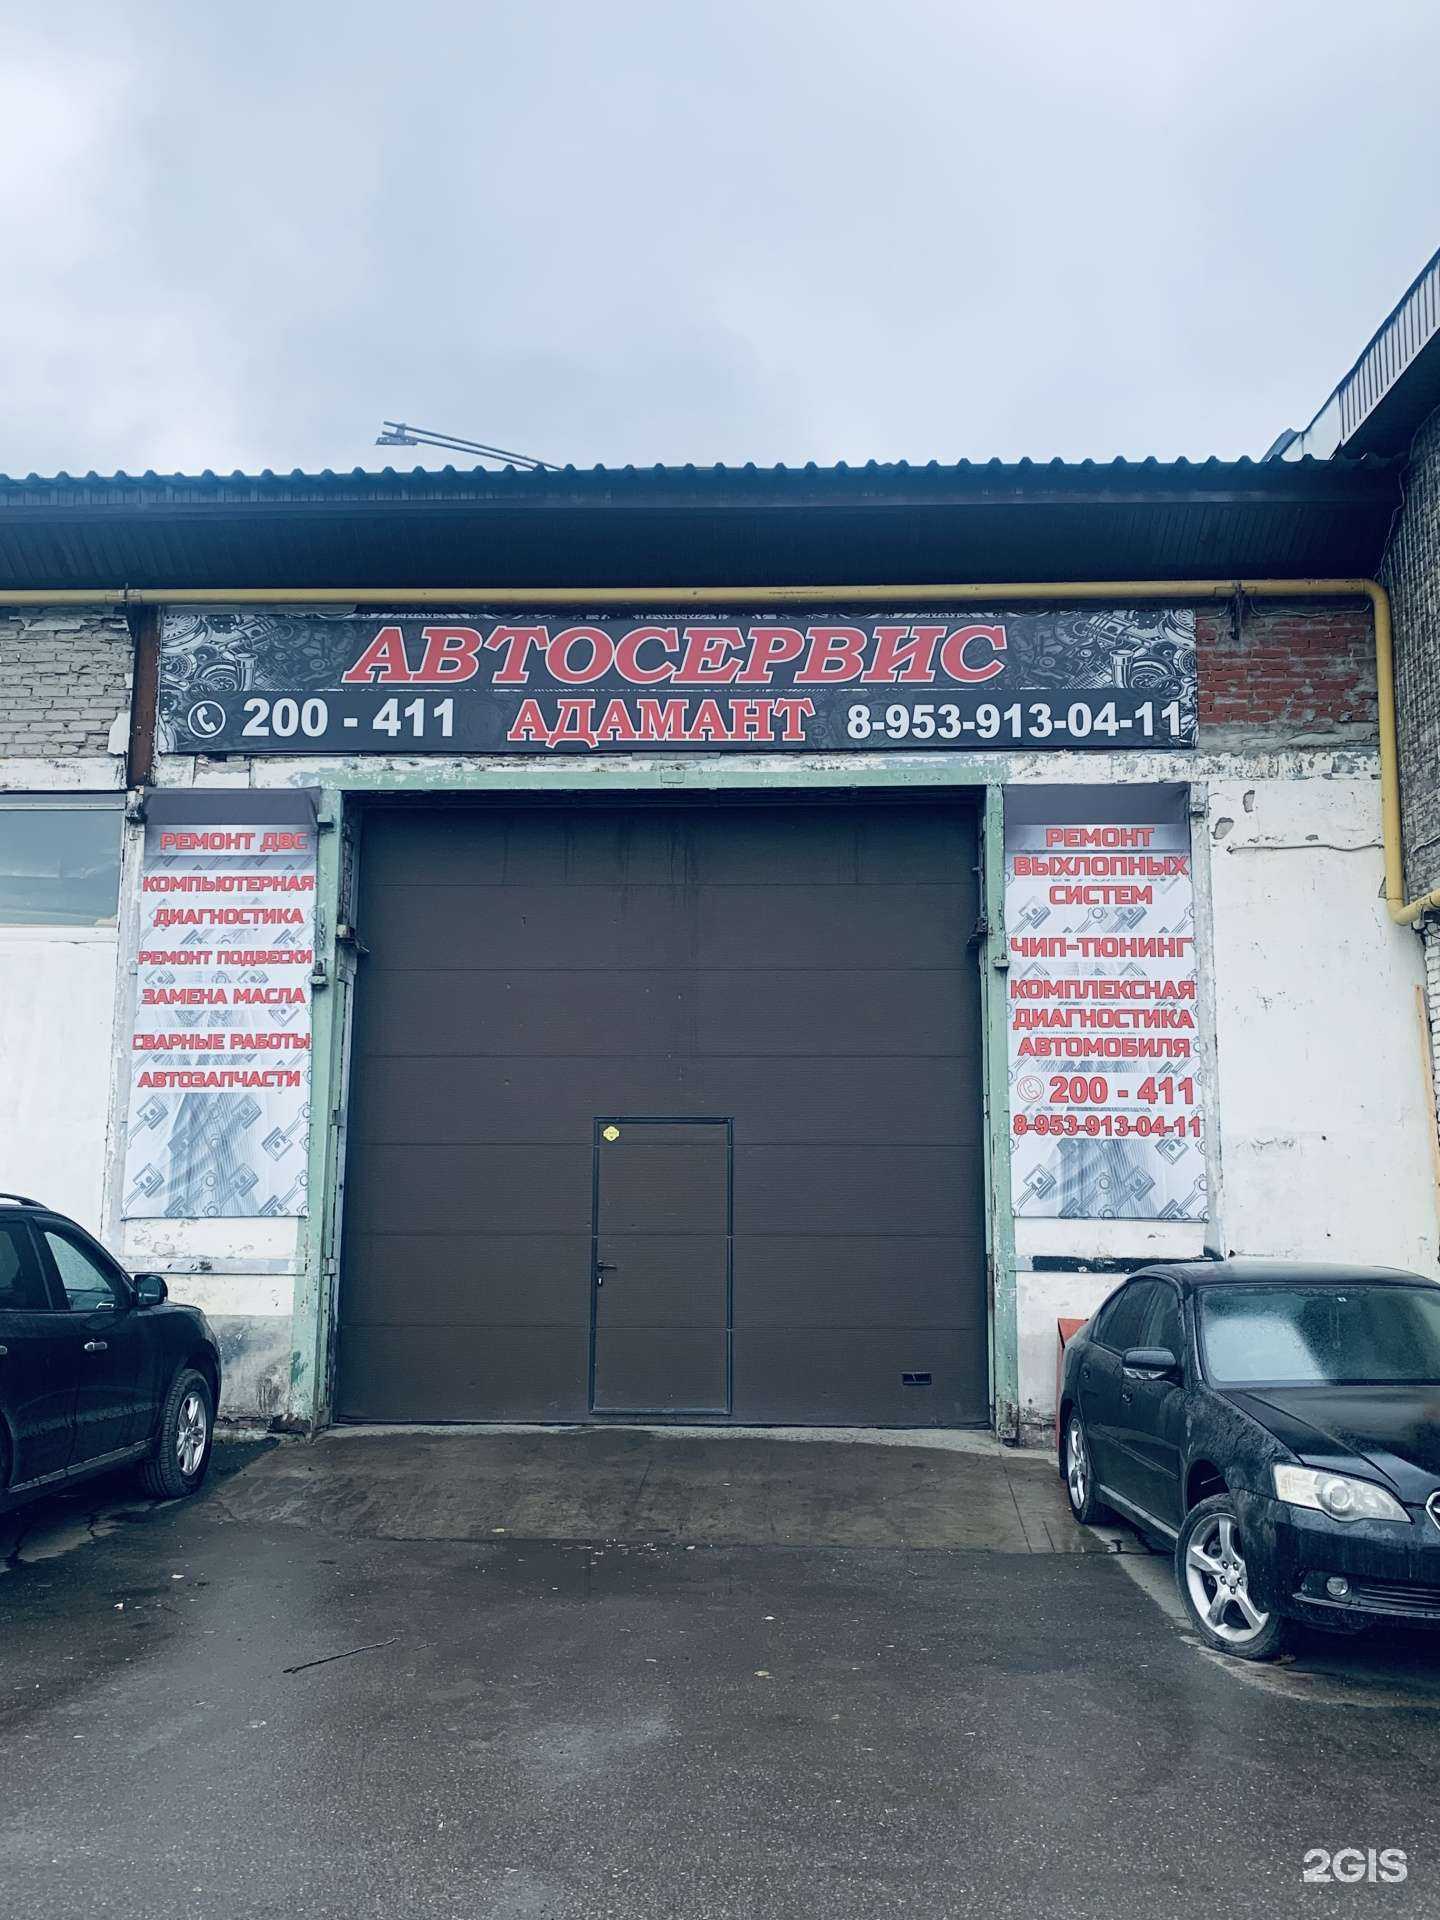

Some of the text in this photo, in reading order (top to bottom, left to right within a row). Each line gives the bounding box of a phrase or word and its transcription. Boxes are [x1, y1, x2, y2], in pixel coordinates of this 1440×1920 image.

[342, 624, 1007, 684] АВТОСЕРВИС
[242, 698, 328, 738] 200
[372, 698, 454, 737] 411
[507, 698, 816, 748] АДАМАНТ
[847, 701, 1181, 739] 8-953-913-04-11
[160, 832, 308, 852] РЕМОНТ ДВС
[1046, 828, 1154, 847] РЕМОНТ
[1014, 856, 1189, 876] ВЫХЛОПНЫХ
[143, 876, 314, 892] КОМПЬЮТЕРНАЯ
[1050, 885, 1153, 905] СИСТЕМ
[153, 908, 304, 927] ДИАГНОСТИКА
[1010, 937, 1194, 957] ЧИП-ТЮНИНГ
[138, 949, 312, 966] РЕМОНТ ПОДВЕСКИ
[141, 987, 306, 1004] ЗАМЕНА МАСЛА
[1010, 980, 1195, 999] КОМПЛЕКСНАЯ
[1013, 1008, 1195, 1030] ДИАГНОСТИКА
[132, 1033, 311, 1050] СВАРНЫЕ РАБОТЫ
[1017, 1037, 1190, 1057] АВТОМОБИЛЯ
[137, 1071, 300, 1087] АВТОЗАПЧАСТИ
[1049, 1075, 1108, 1103] 200
[1137, 1076, 1194, 1104] 411
[1013, 1114, 1201, 1137] 8-953-913-04-11
